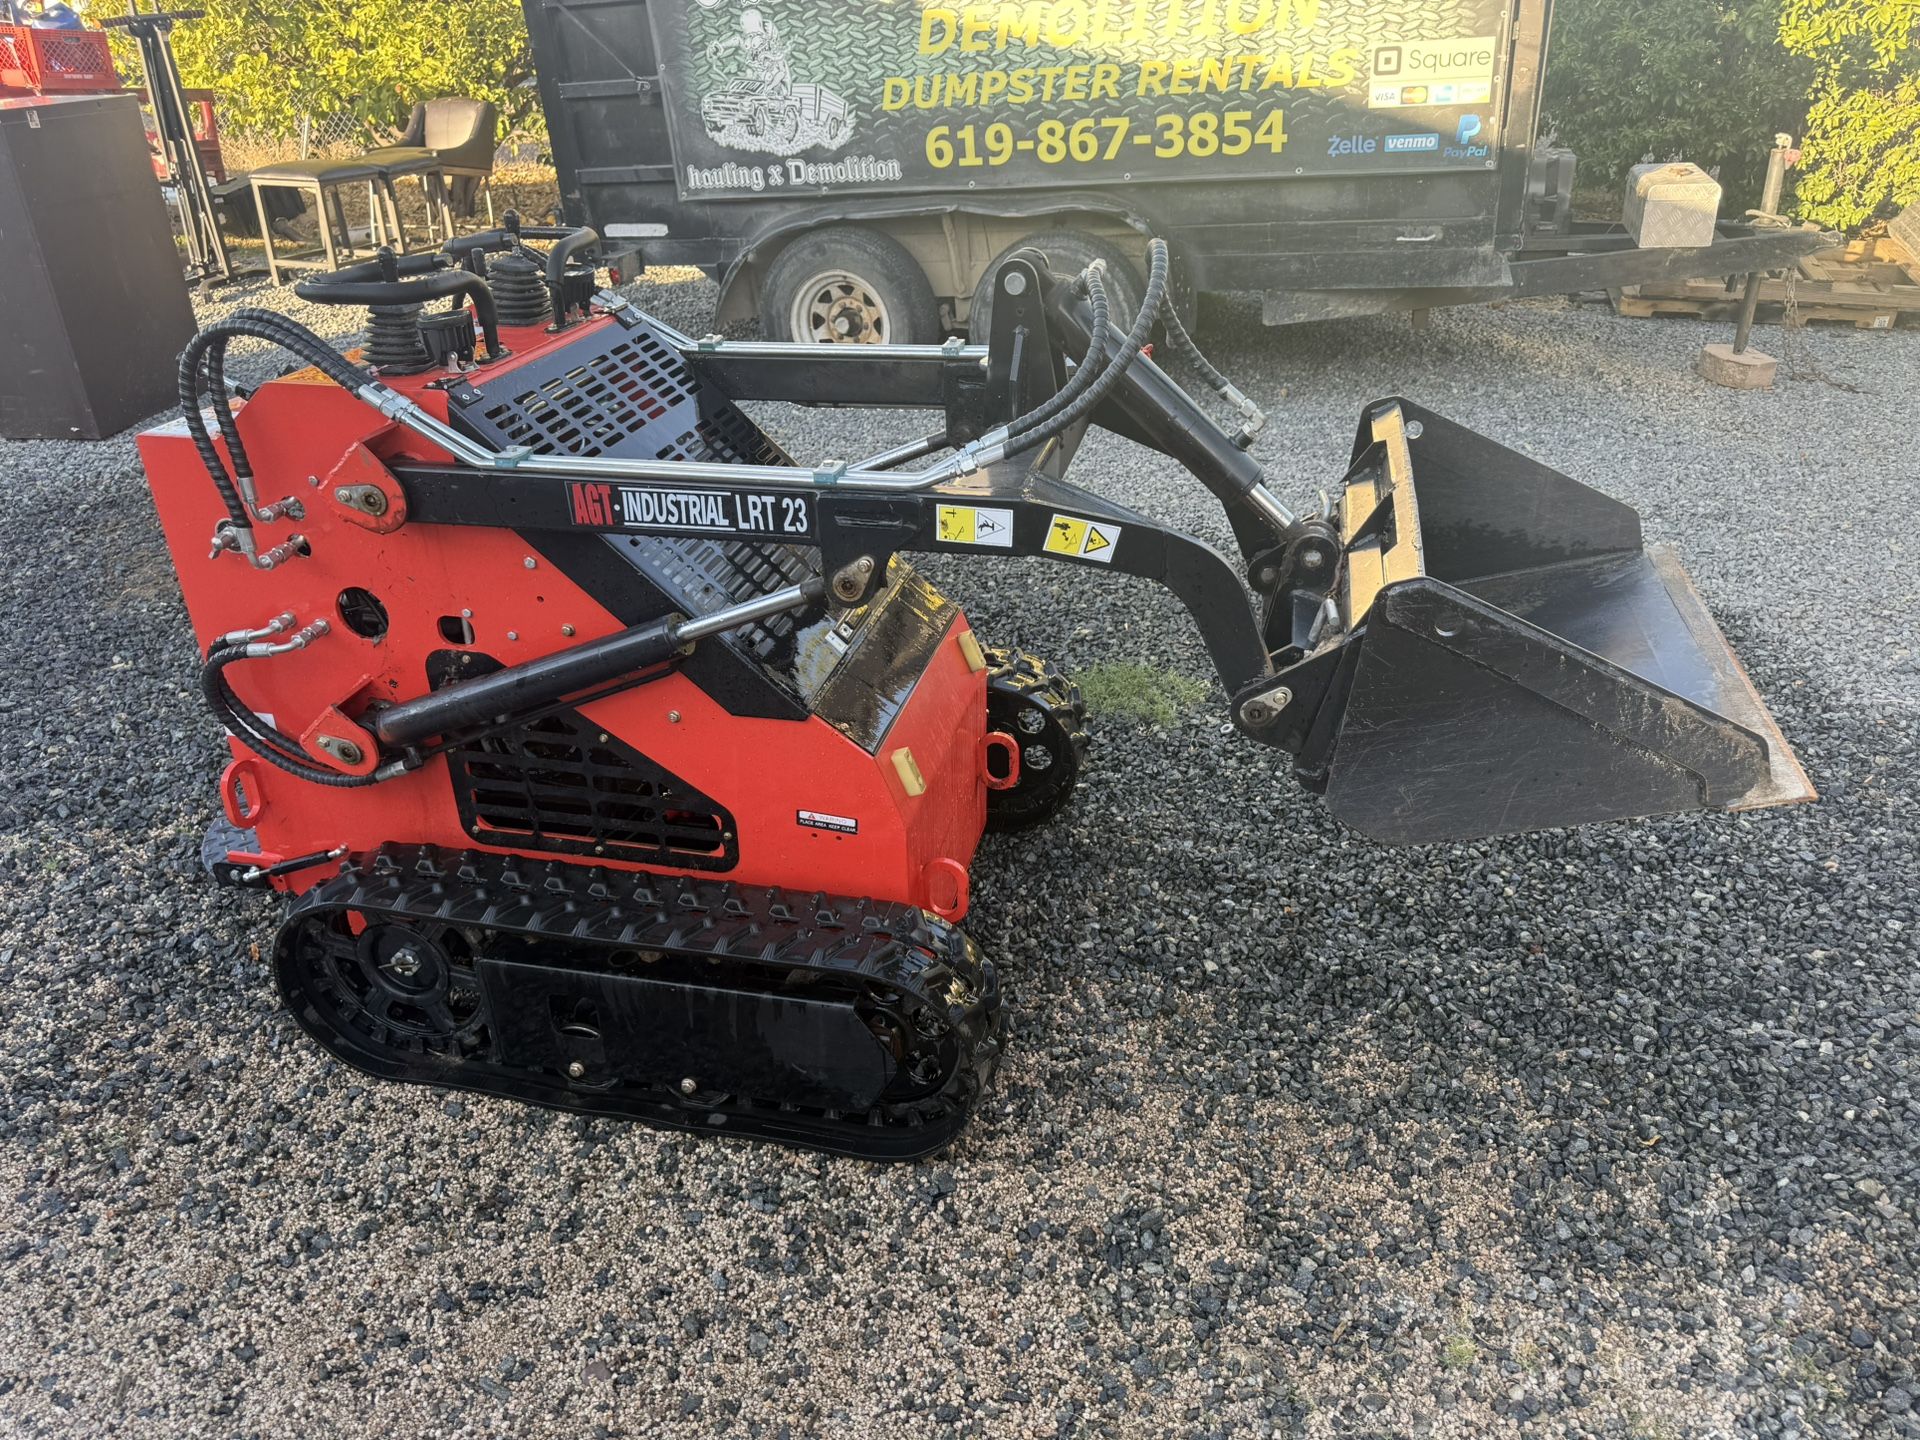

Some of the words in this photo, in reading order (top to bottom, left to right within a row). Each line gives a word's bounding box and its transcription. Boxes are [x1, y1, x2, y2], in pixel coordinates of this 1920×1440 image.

[918, 0, 1320, 54] DEMOLITION
[882, 63, 1121, 111] DUMPSTER
[1136, 48, 1358, 96] RENTALS
[1408, 49, 1492, 73] Square
[1375, 92, 1396, 102] VISA
[925, 109, 1288, 168] 619-867-3854
[1388, 136, 1435, 149] venmo
[1443, 145, 1488, 160] PayPal
[687, 162, 766, 191] hauling
[785, 154, 902, 186] Demolition
[571, 482, 614, 526] AGT
[622, 491, 730, 527] INDUSTRIAL
[735, 494, 776, 532] LRT
[782, 497, 808, 533] 23
